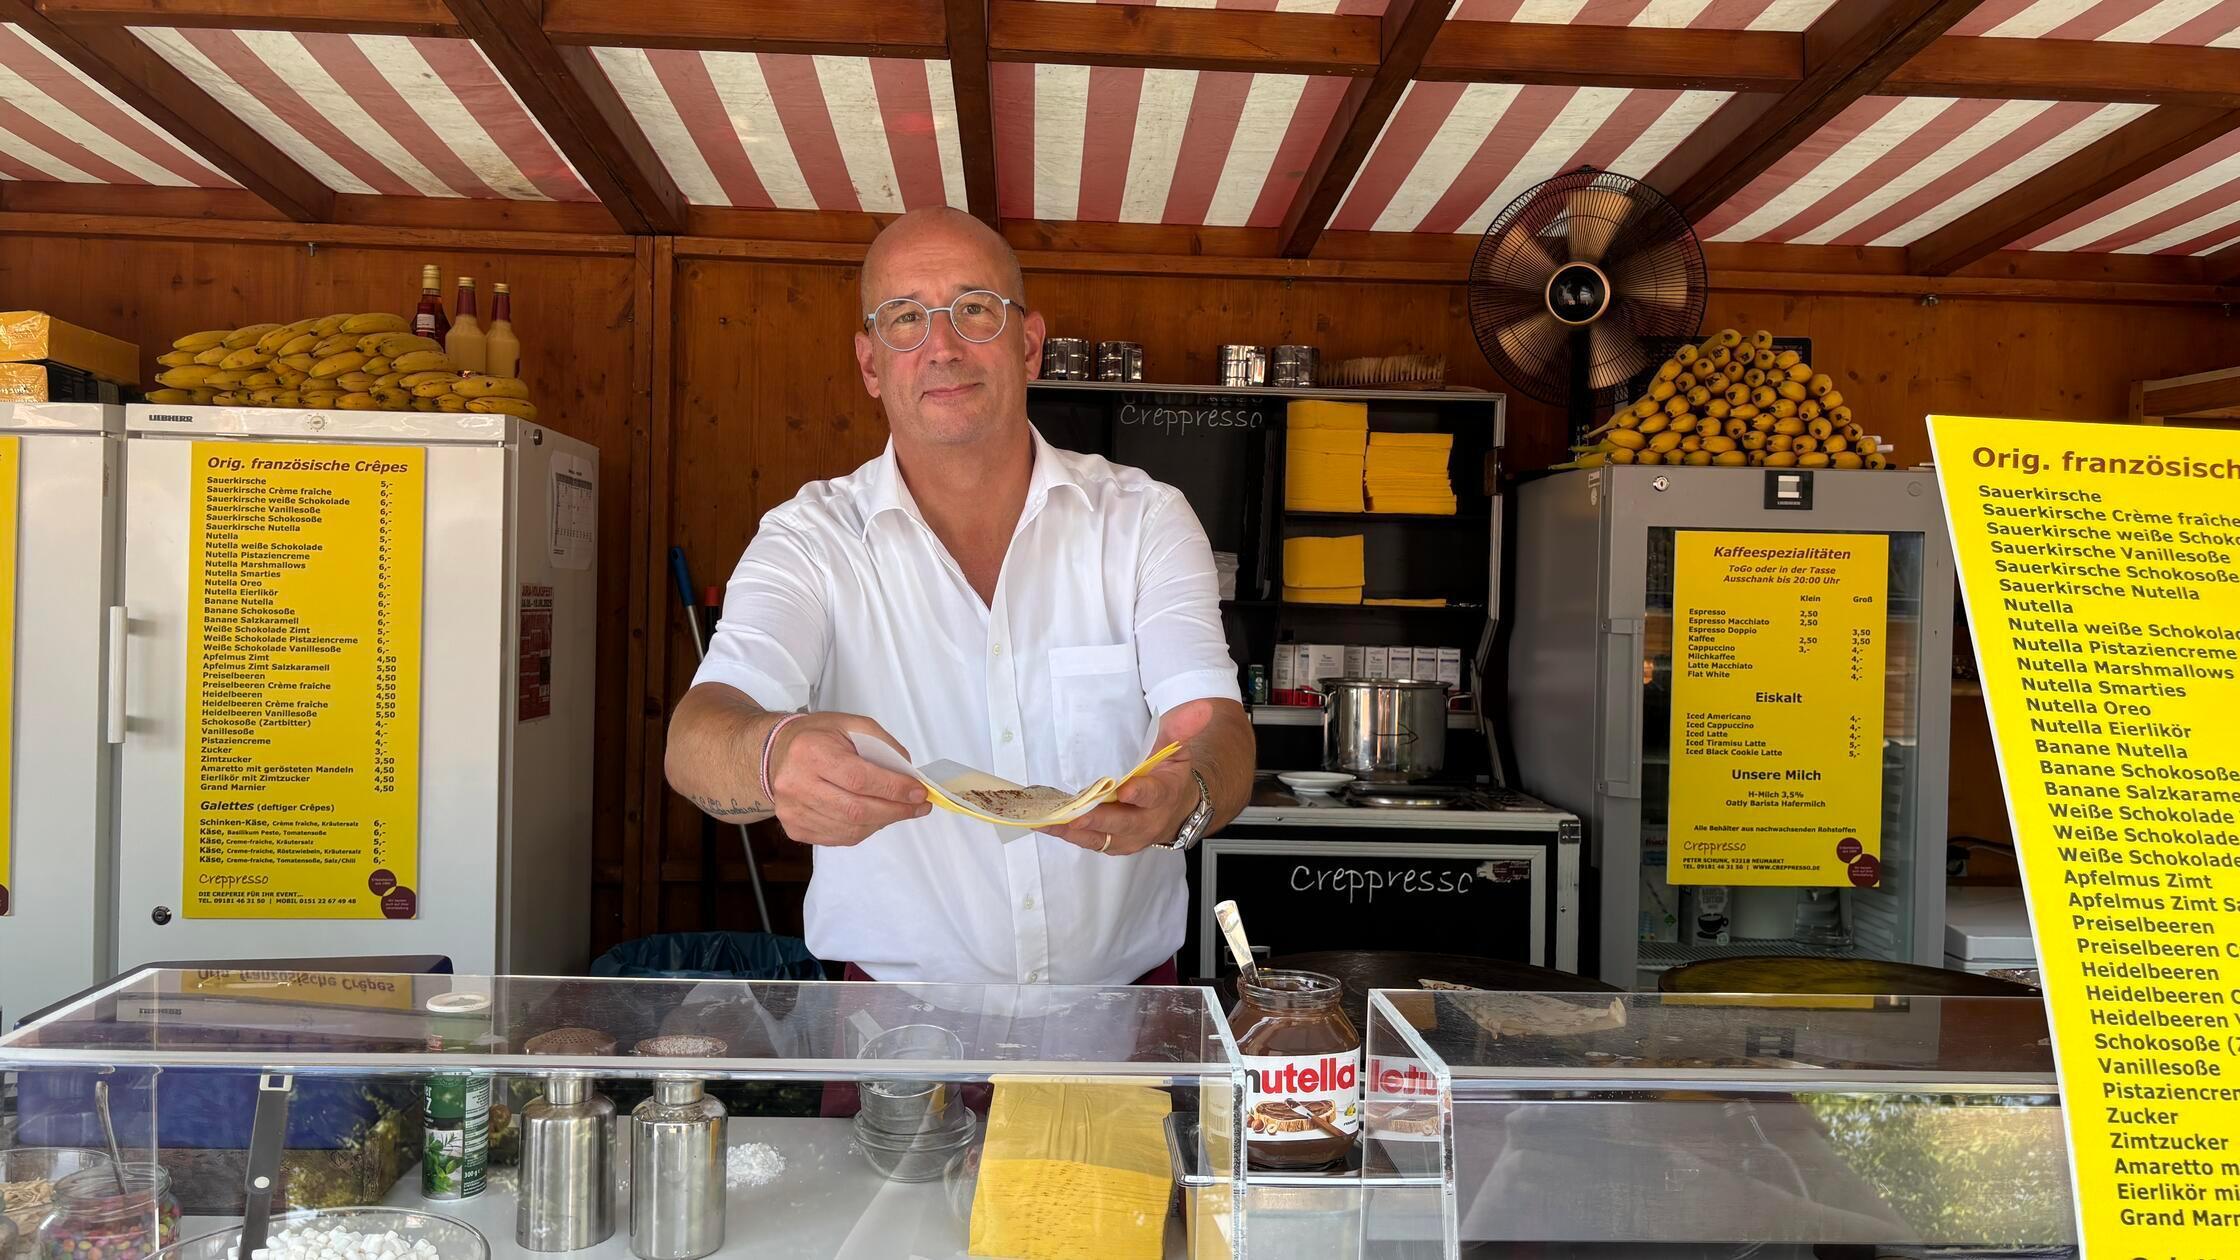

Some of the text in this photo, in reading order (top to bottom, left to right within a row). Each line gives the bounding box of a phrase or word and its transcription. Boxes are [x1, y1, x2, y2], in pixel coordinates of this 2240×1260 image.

[1120, 404, 1263, 436] Creppresso
[207, 457, 408, 474] Orig. französische Crêpes
[1972, 447, 2240, 478] Orig. französisch
[1978, 485, 2102, 502] Sauerkirsche
[1982, 504, 2240, 527] Sauerkirsche Crème fraîche
[1986, 522, 2111, 539] Sauerkirsche
[2116, 529, 2173, 542] weiße
[1713, 547, 1850, 560] Kaffeespezialitäten
[1990, 541, 2230, 564] Sauerkirsche Vanillesoße
[1776, 576, 1791, 584] bis
[1994, 560, 2240, 583] Sauerkirsche Schokosoße
[1999, 579, 2199, 600] Sauerkirsche Nutella
[2003, 598, 2073, 613] Nutella
[1727, 627, 1757, 635] Doppio
[2008, 618, 2078, 633] Nutella
[2084, 622, 2143, 636] weiße
[1688, 644, 1735, 652] Cappuccino
[2012, 638, 2237, 659] Nutella Pistaziencreme
[2017, 658, 2234, 679] Nutella Marshmallows
[2021, 678, 2186, 697] Nutella Smarties
[1756, 692, 1802, 703] Eiskalt
[2025, 698, 2151, 716] Nutella Oreo
[259, 719, 311, 727] (Zartbitter)
[1706, 722, 1754, 730] Cappuccino
[2030, 719, 2191, 738] Nutella Eierlikör
[2035, 739, 2188, 758] Banane Nutella
[1732, 770, 1821, 780] Unsere Milch
[2039, 760, 2240, 781] Banane Schokosoße
[2044, 782, 2240, 802] Banane Salzkarame
[200, 801, 334, 812] Galettes (deftiger Crêpes)
[2048, 804, 2235, 824] Weiße Schokolade
[2052, 825, 2240, 845] Weiße Schokolade
[1683, 841, 1746, 854] Creppresso
[2057, 848, 2240, 867] Weiße Schokolade
[198, 874, 268, 888] Creppresso
[1290, 866, 1473, 904] Creppresso
[2064, 870, 2213, 889] Apfelmus Zimt
[2068, 892, 2165, 910] Apfelmus
[2170, 896, 2218, 911] Zimt
[2072, 915, 2214, 934] Preiselbeeren
[2077, 938, 2219, 957] Preiselbeeren
[2081, 962, 2219, 980] Heidelbeeren
[2086, 986, 2224, 1004] Heidelbeeren
[2090, 1010, 2229, 1028] Heidelbeeren
[2094, 1034, 2220, 1051] Schokosoße
[1245, 1057, 1354, 1094] nutella
[2097, 1058, 2220, 1076] Vanillesoße
[2106, 1108, 2178, 1124] Zucker
[2110, 1133, 2228, 1150] Zimtzucker
[2114, 1158, 2213, 1175] Amaretto
[2117, 1183, 2207, 1200] Eierlikör
[2120, 1209, 2184, 1226] Grand
